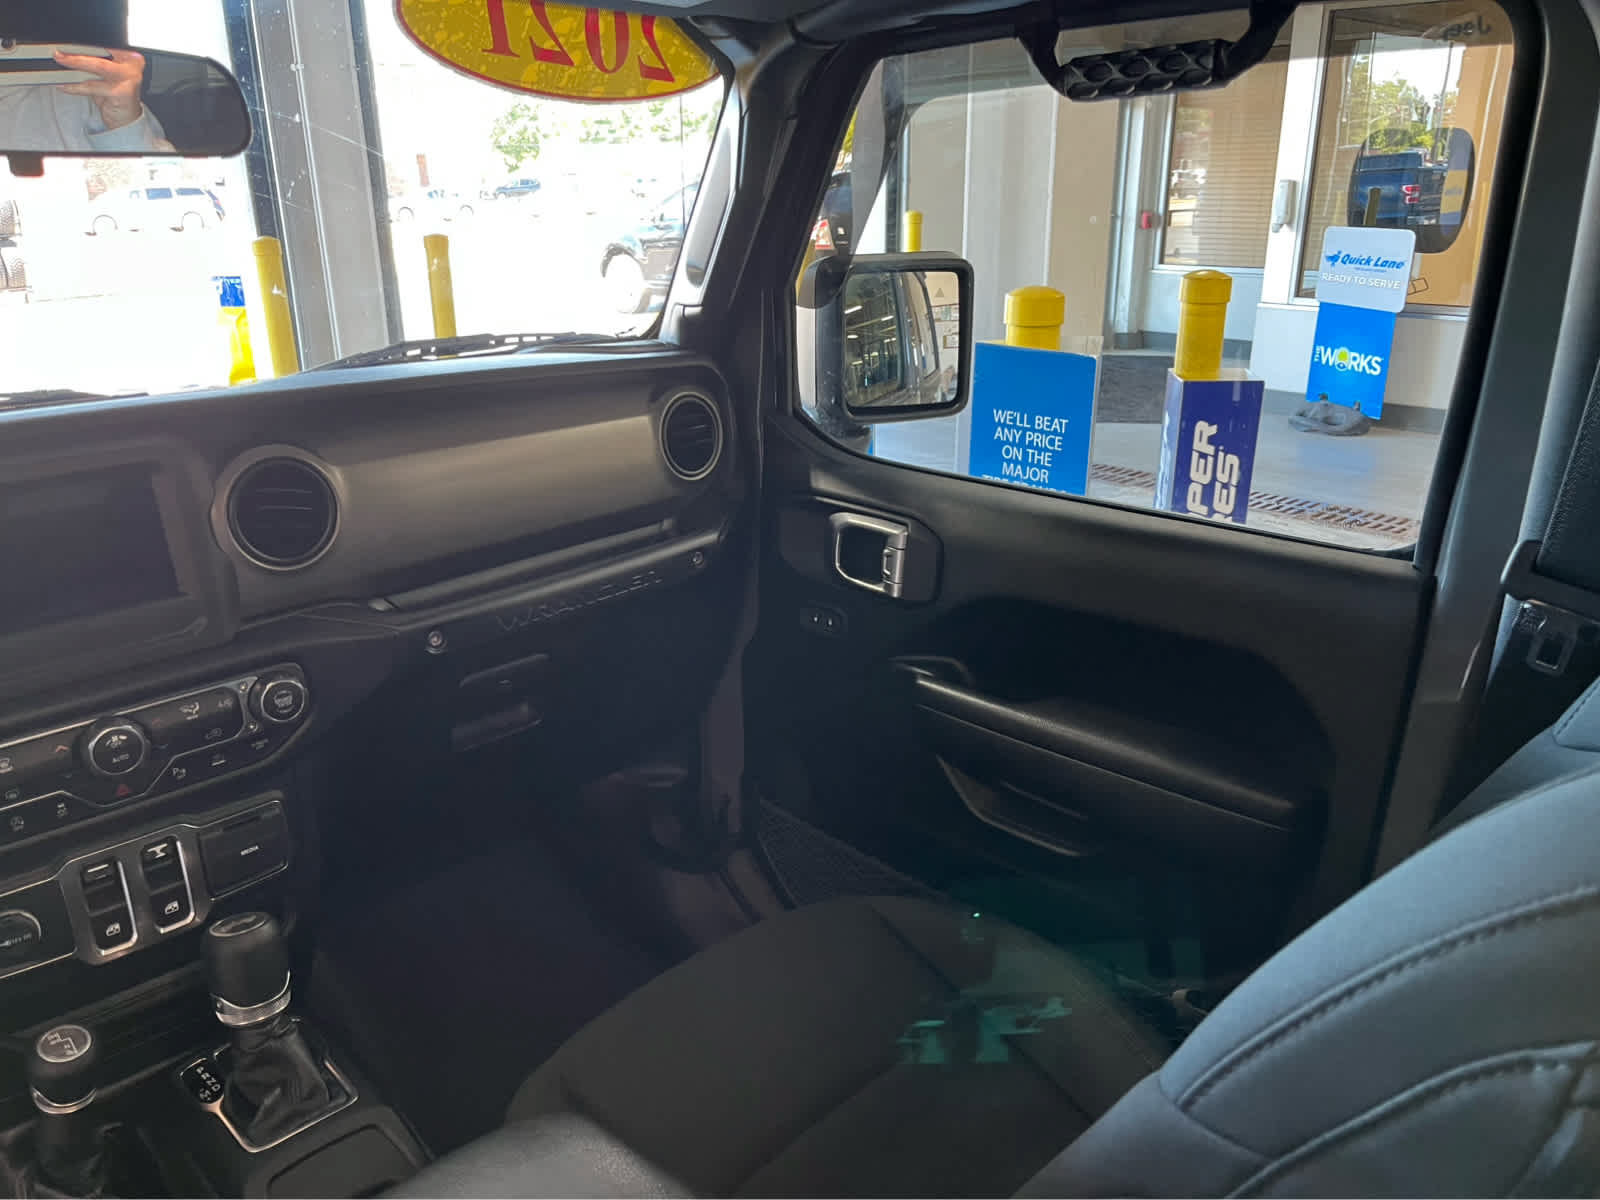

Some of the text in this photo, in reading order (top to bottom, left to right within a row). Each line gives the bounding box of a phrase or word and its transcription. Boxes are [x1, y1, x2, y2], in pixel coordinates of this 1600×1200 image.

[1340, 253, 1405, 269] Quick Lane
[1322, 272, 1401, 289] READY TO SERVE
[1320, 345, 1382, 376] WORKS
[992, 407, 1069, 434] WE'LL BEAT
[993, 426, 1063, 451] ANY PRICE
[1001, 444, 1053, 467] ON THE
[1001, 461, 1049, 484] MAJOR
[1186, 420, 1218, 519] PER
